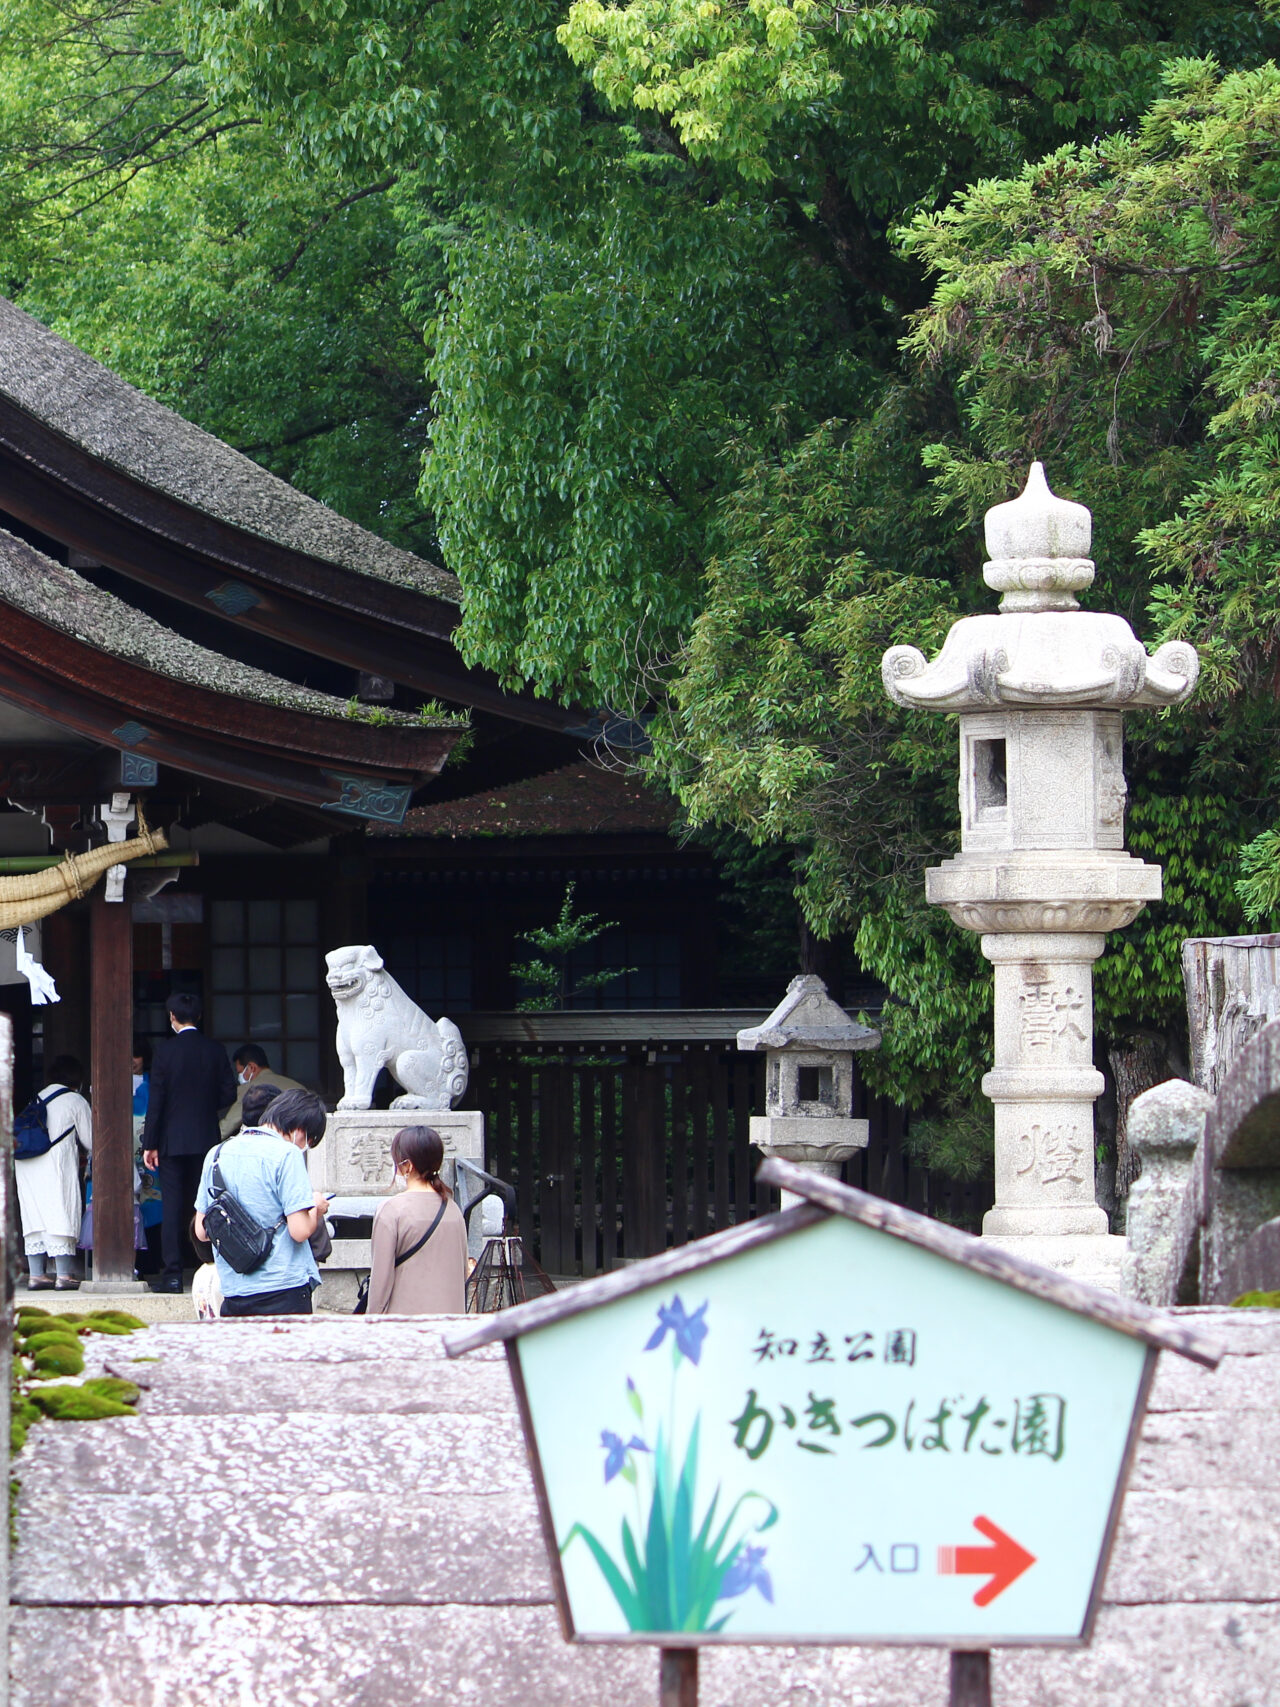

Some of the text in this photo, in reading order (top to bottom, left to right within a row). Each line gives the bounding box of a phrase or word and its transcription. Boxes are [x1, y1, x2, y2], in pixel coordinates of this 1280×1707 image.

[752, 1327, 917, 1368] 知立公園
[729, 1387, 1068, 1463] かきつばた園
[853, 1542, 920, 1574] 入口
